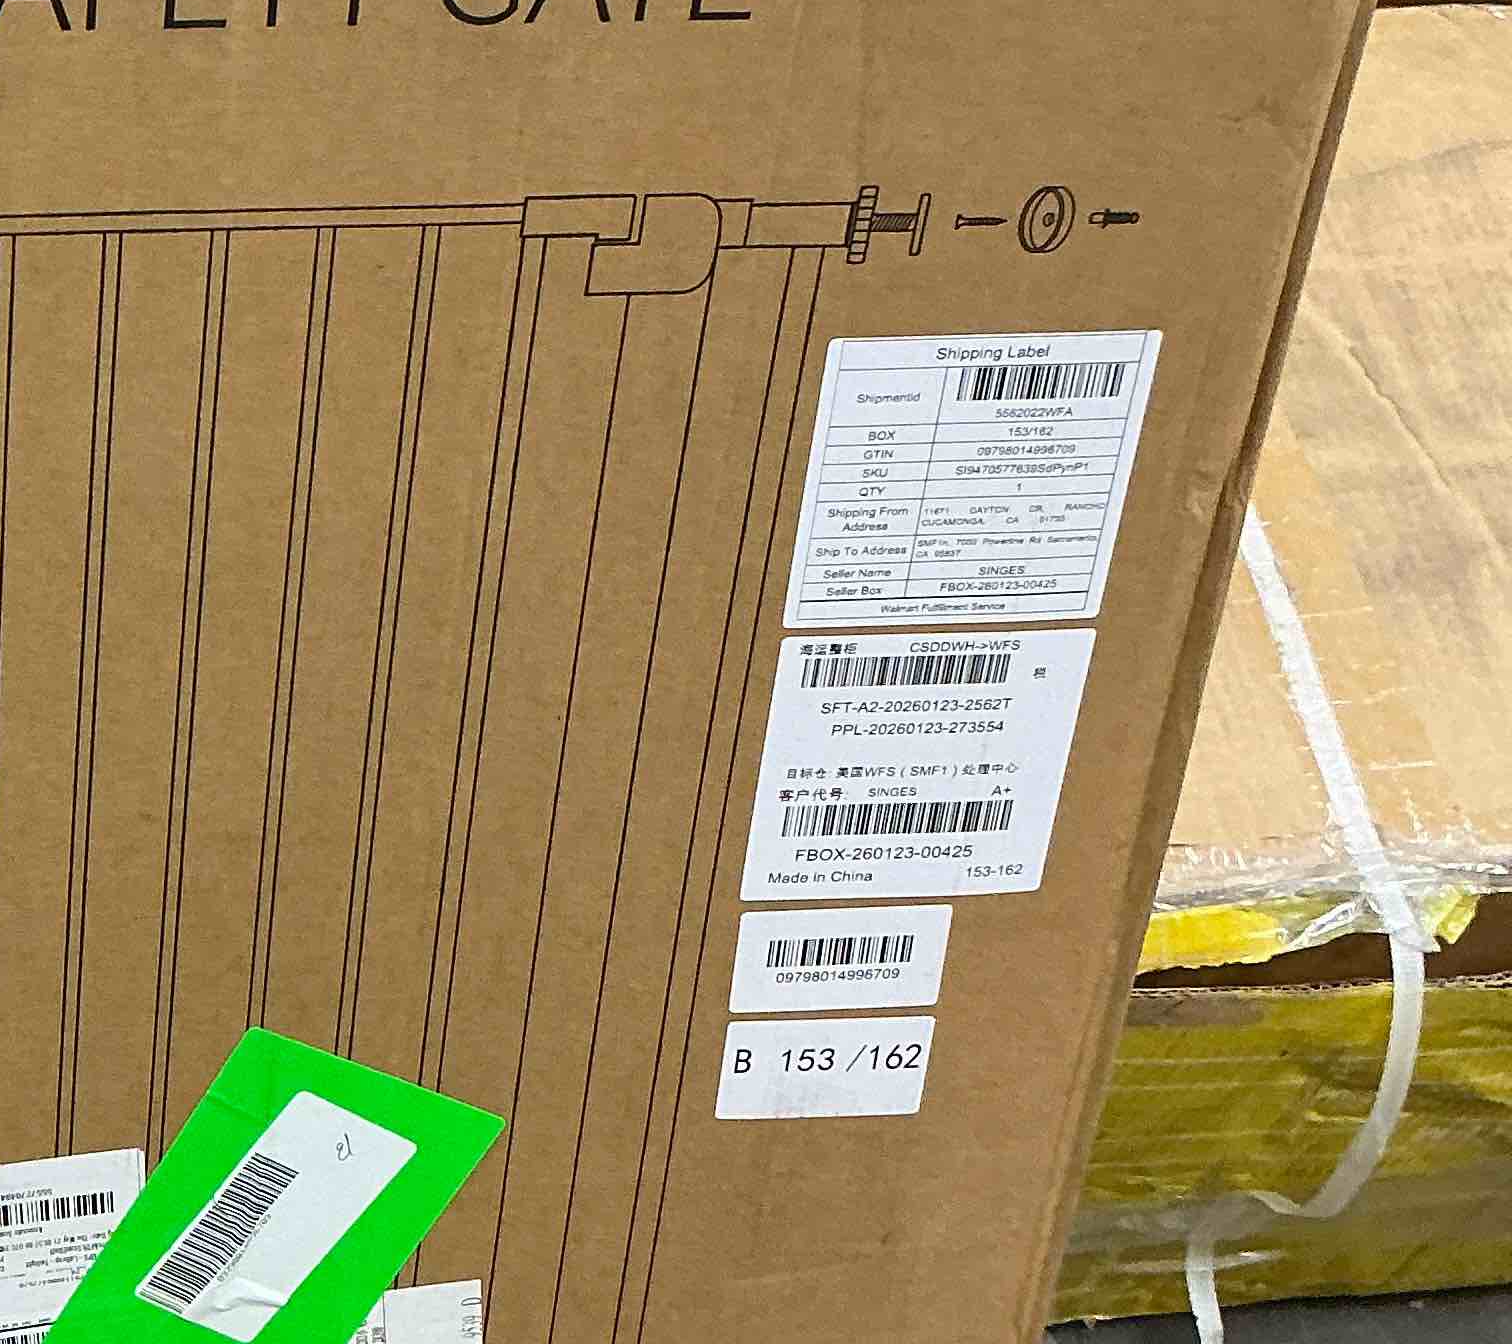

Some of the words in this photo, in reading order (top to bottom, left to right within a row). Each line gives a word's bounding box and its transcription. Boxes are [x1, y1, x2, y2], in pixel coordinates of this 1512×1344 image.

[936, 347, 1003, 362] Shipping
[1007, 345, 1050, 359] Label
[868, 430, 896, 441] BOX
[863, 449, 894, 460] GTIN
[863, 467, 889, 478] SKU
[859, 486, 886, 497] QTY
[828, 507, 874, 521] Shipping
[878, 506, 909, 517] From
[842, 521, 889, 532] Address
[816, 546, 841, 558] Ship
[844, 545, 858, 556] To
[860, 544, 908, 556] Address
[823, 569, 856, 579] Seller
[858, 567, 892, 578] Name
[977, 565, 1025, 576] SINGES
[826, 586, 859, 596] Seller
[861, 585, 882, 596] Box
[831, 720, 1005, 737] PPL-20260123-273554
[868, 787, 917, 797] SINGES
[991, 785, 1012, 797] A+
[794, 845, 973, 862] FBOX-260123-00425
[966, 864, 1024, 878] 153-162
[767, 872, 809, 884] Made
[830, 871, 873, 883] China
[733, 1048, 752, 1074] B
[781, 1048, 835, 1072] 153
